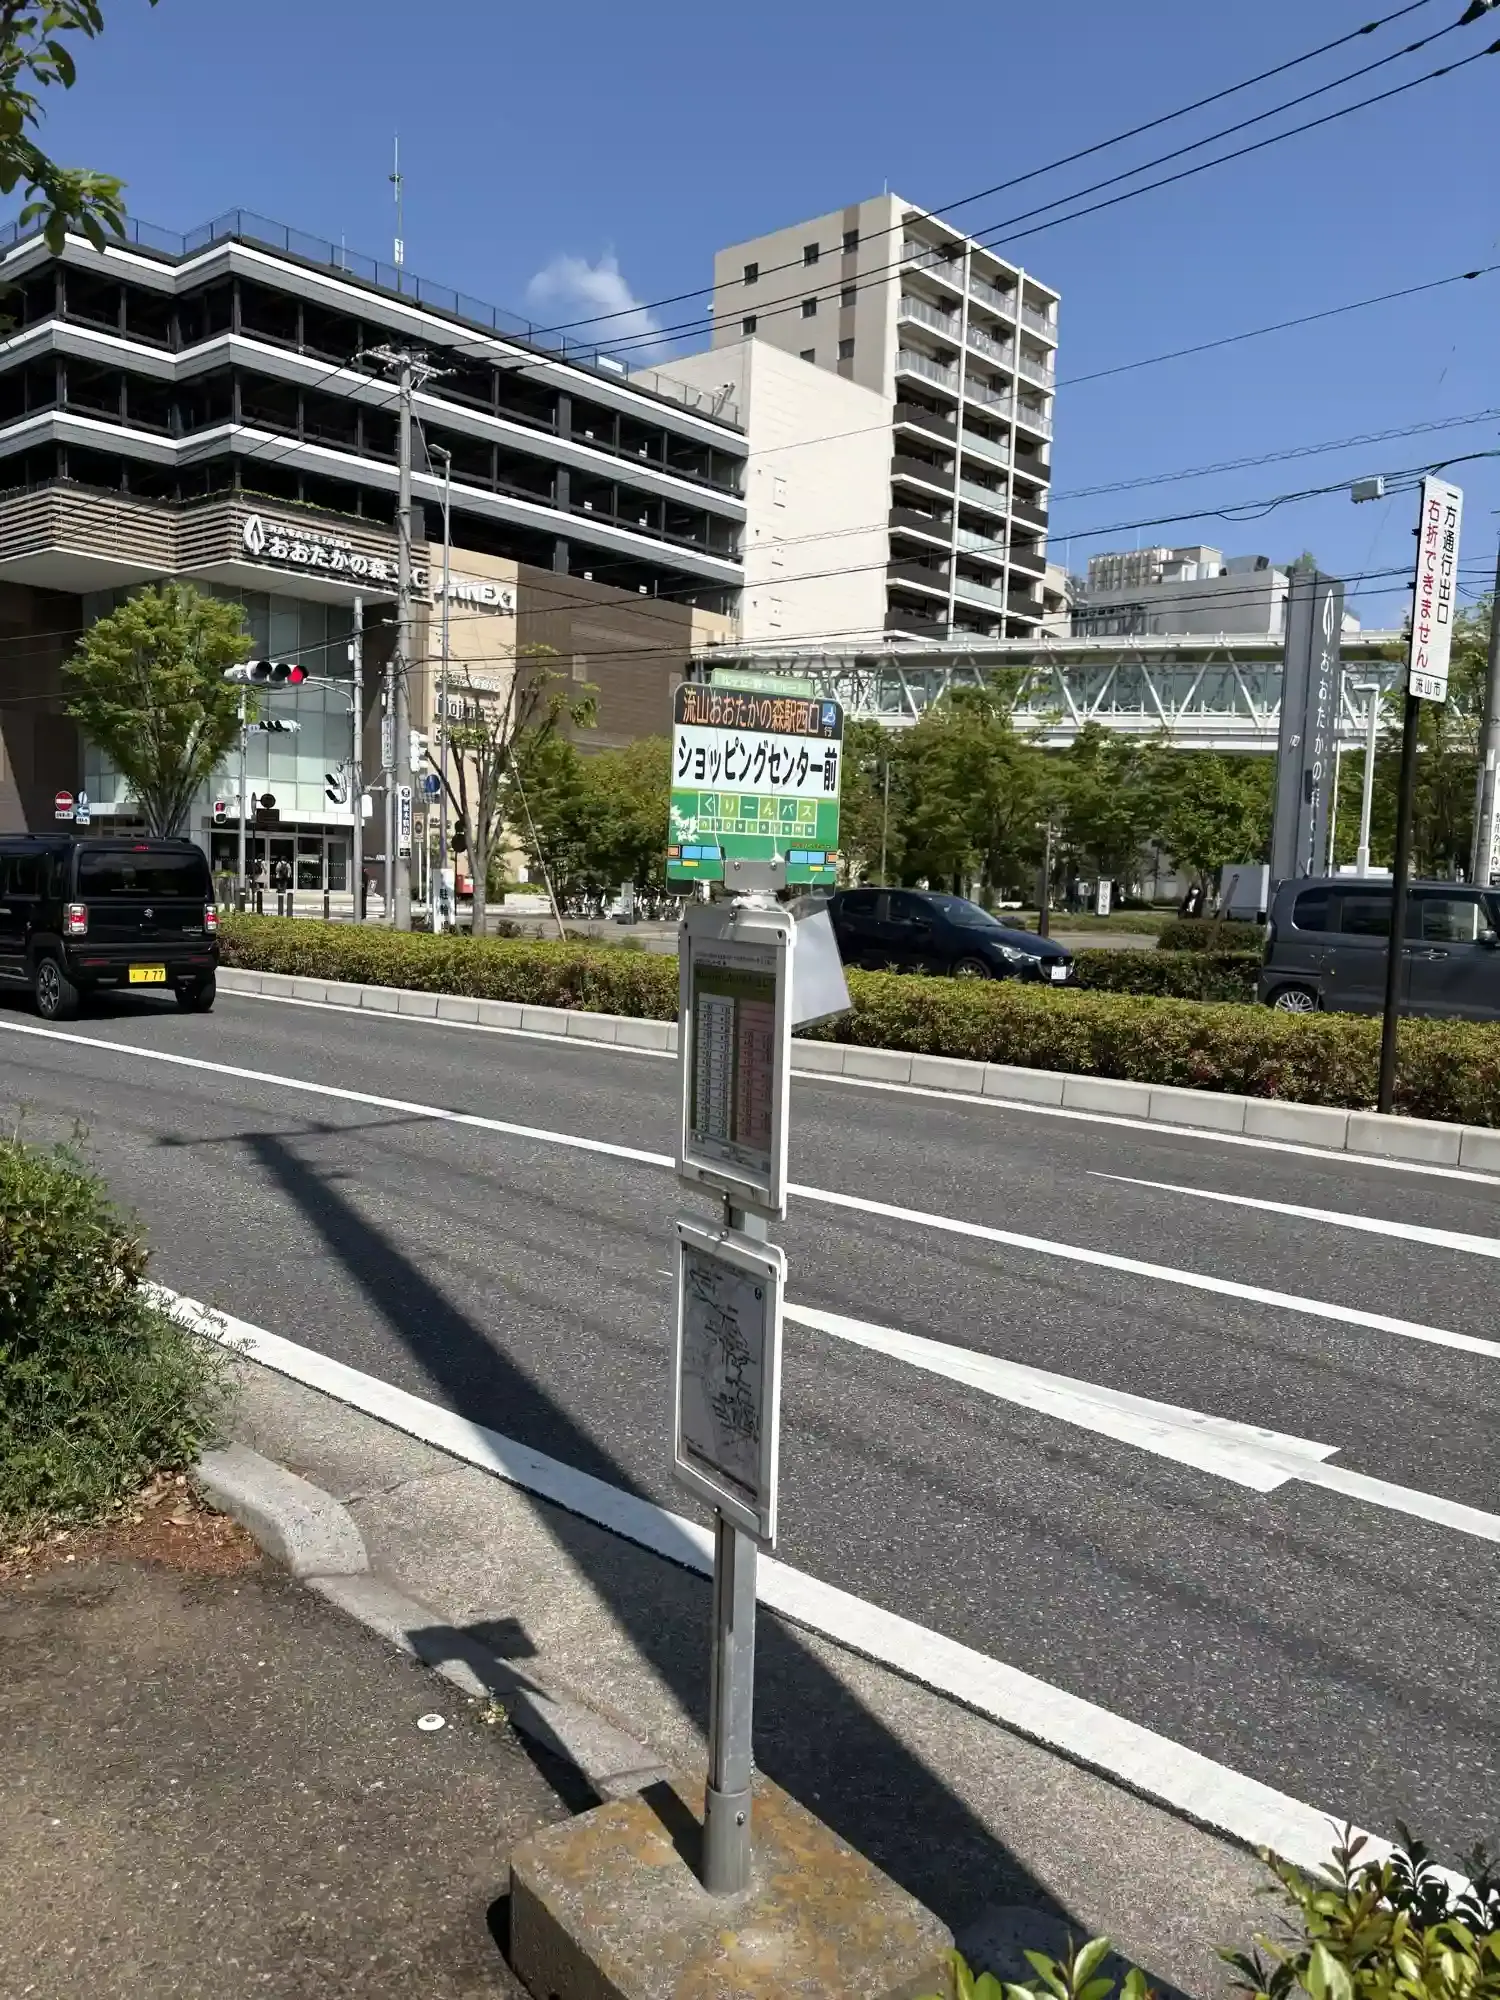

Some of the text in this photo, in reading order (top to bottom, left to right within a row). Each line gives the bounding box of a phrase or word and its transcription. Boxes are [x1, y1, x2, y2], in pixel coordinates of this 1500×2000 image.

[1416, 499, 1440, 668] 右折できません
[1437, 491, 1458, 624] 一方通行出口
[682, 686, 833, 737] 流山おおたかの森駅西口 行
[1415, 677, 1441, 697] 流山市
[678, 735, 838, 791] ショッピングセンター前
[704, 796, 812, 818] ぐりーんバス
